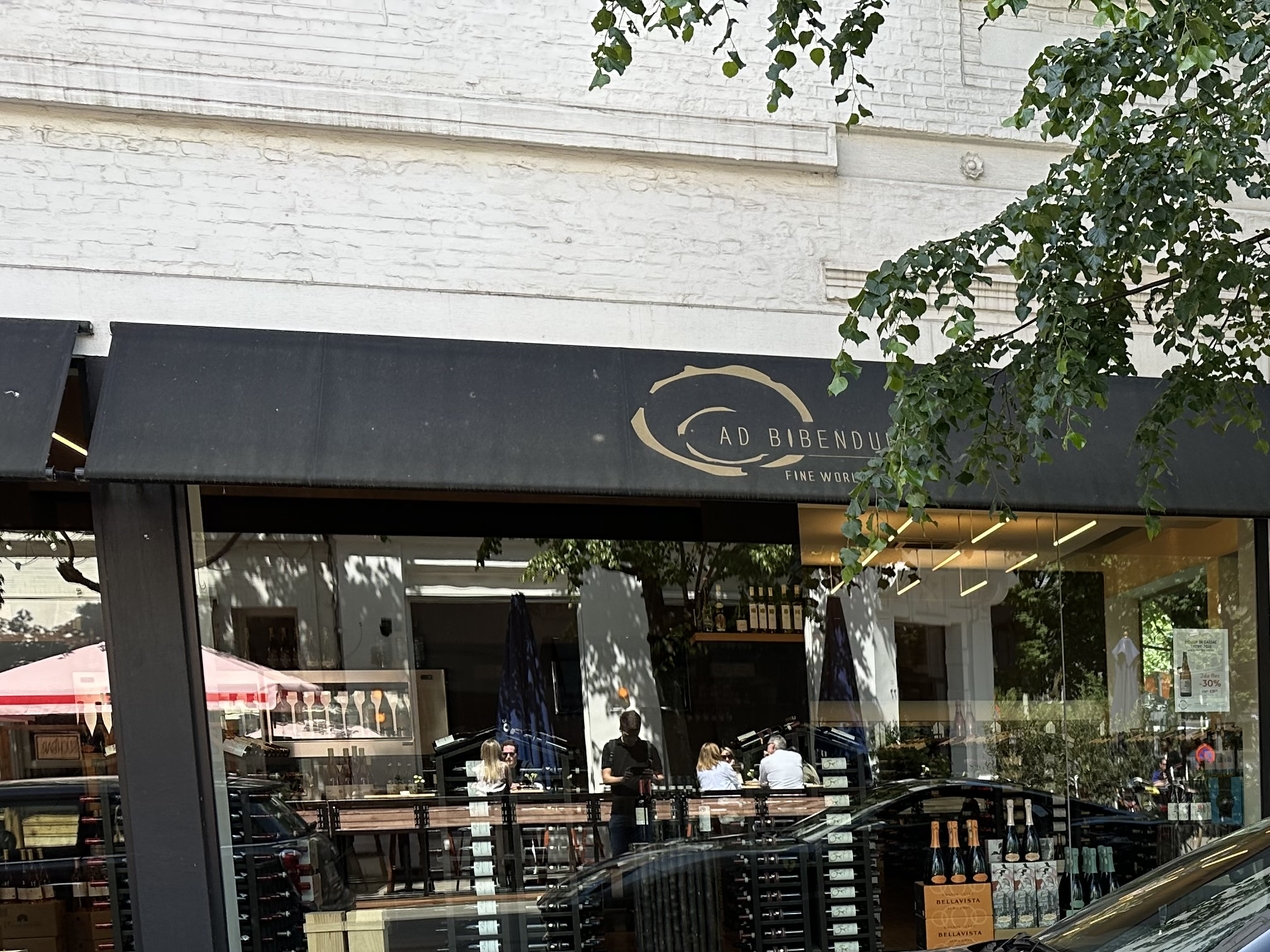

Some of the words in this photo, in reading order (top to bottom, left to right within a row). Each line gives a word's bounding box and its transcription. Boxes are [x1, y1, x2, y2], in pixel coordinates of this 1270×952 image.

[720, 426, 749, 446] AD
[785, 470, 815, 482] FINE
[819, 471, 859, 484] WORL
[1199, 679, 1222, 688] -30%
[938, 930, 983, 938] BELLAVISTA
